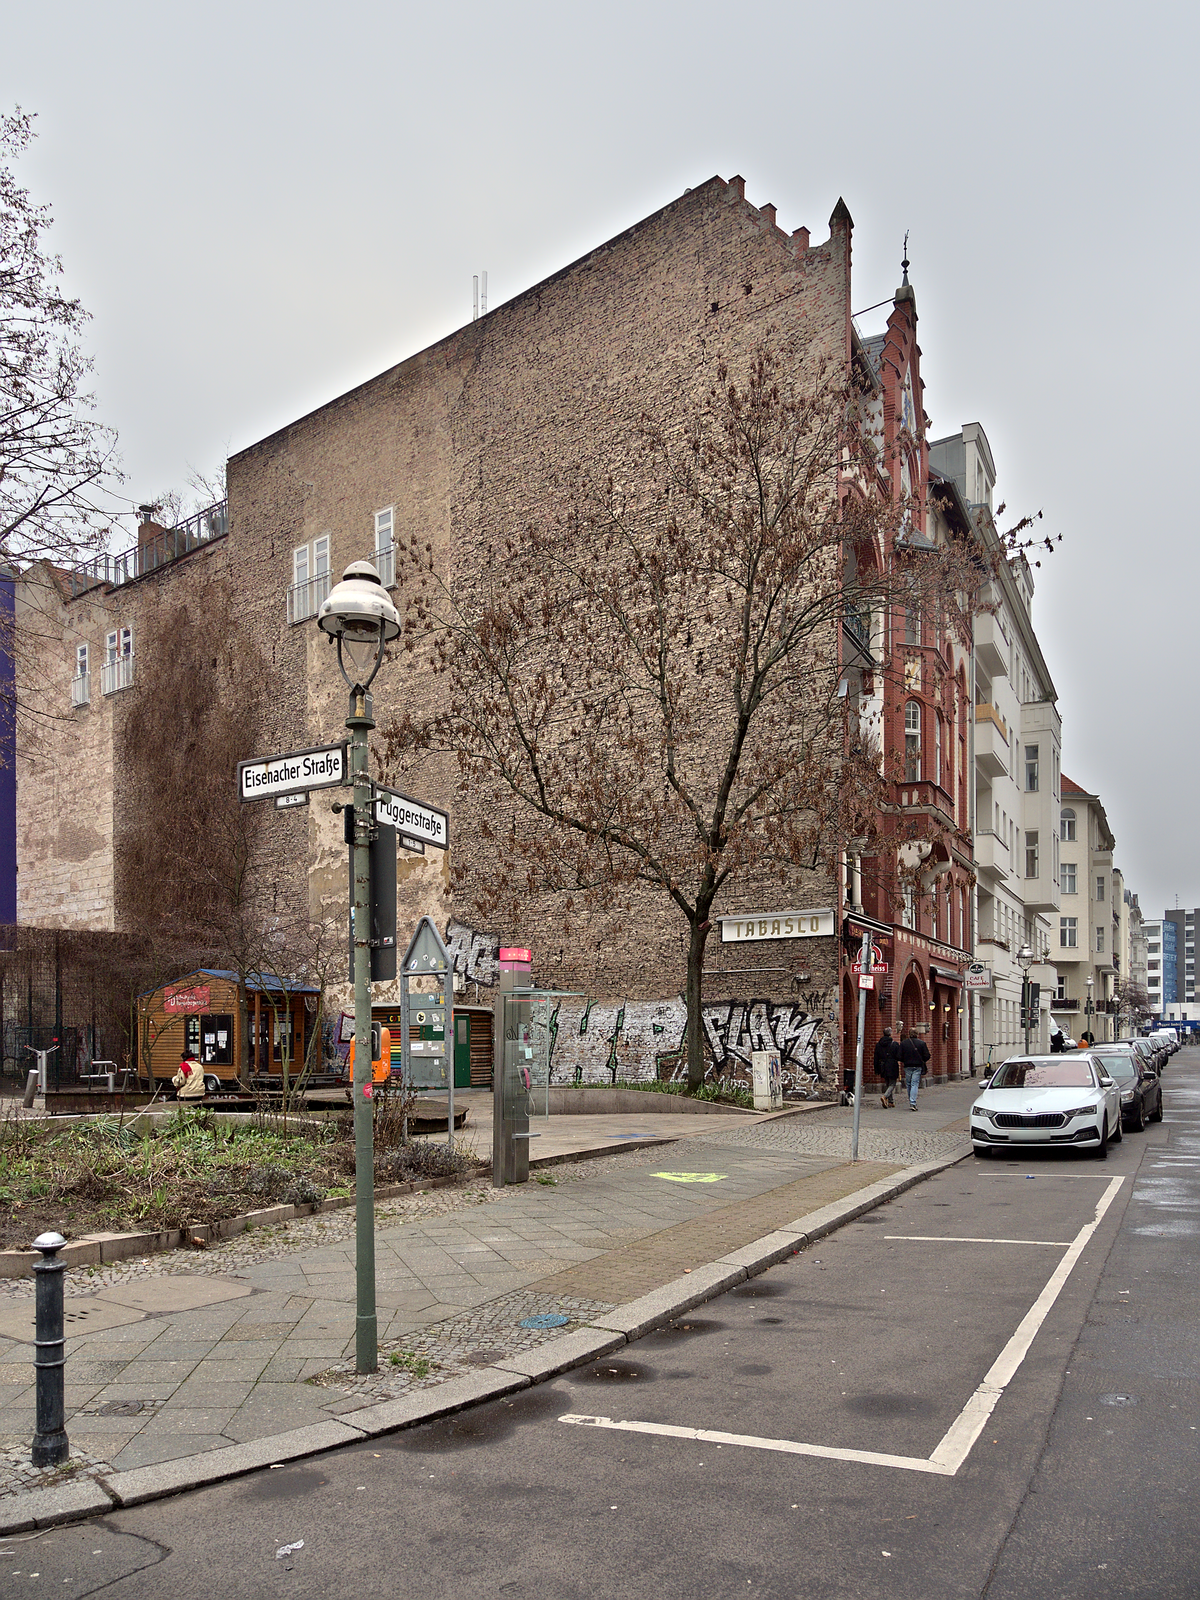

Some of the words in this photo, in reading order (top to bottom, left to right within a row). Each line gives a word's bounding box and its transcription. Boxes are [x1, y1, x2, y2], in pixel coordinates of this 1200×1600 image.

[245, 763, 301, 788] Eisenacher
[302, 753, 340, 776] Straße
[734, 916, 820, 938] TABASCO
